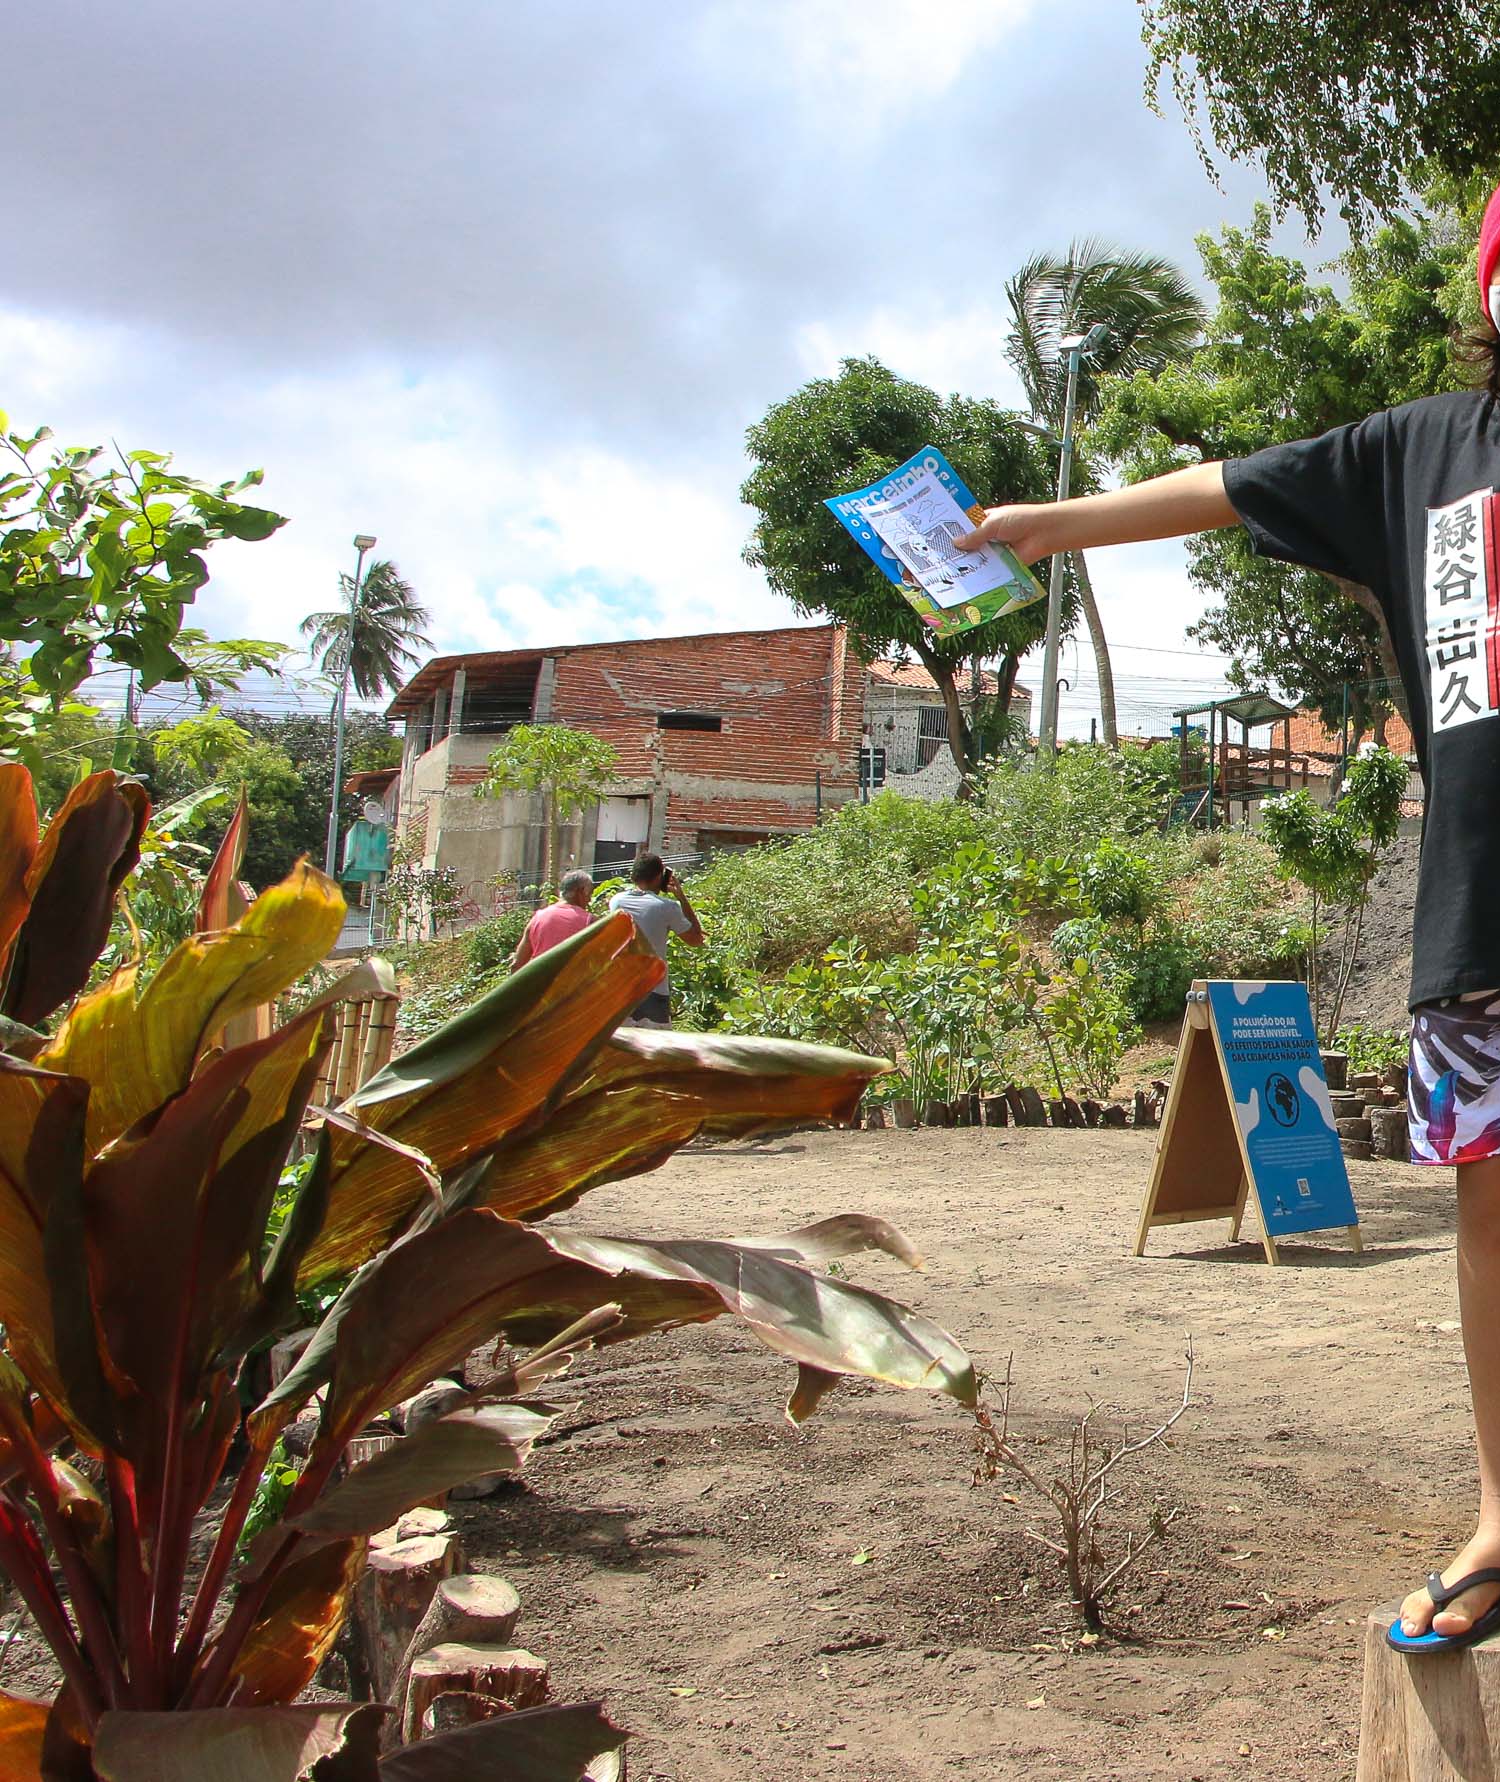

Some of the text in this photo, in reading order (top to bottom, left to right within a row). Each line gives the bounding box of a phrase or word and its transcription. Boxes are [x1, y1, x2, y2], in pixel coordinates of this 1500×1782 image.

[1433, 503, 1482, 725] 緑谷出久
[1274, 1017, 1286, 1026] DO
[1286, 1016, 1297, 1026] AR
[1232, 1029, 1253, 1039] PODE
[1252, 1029, 1266, 1038] SER
